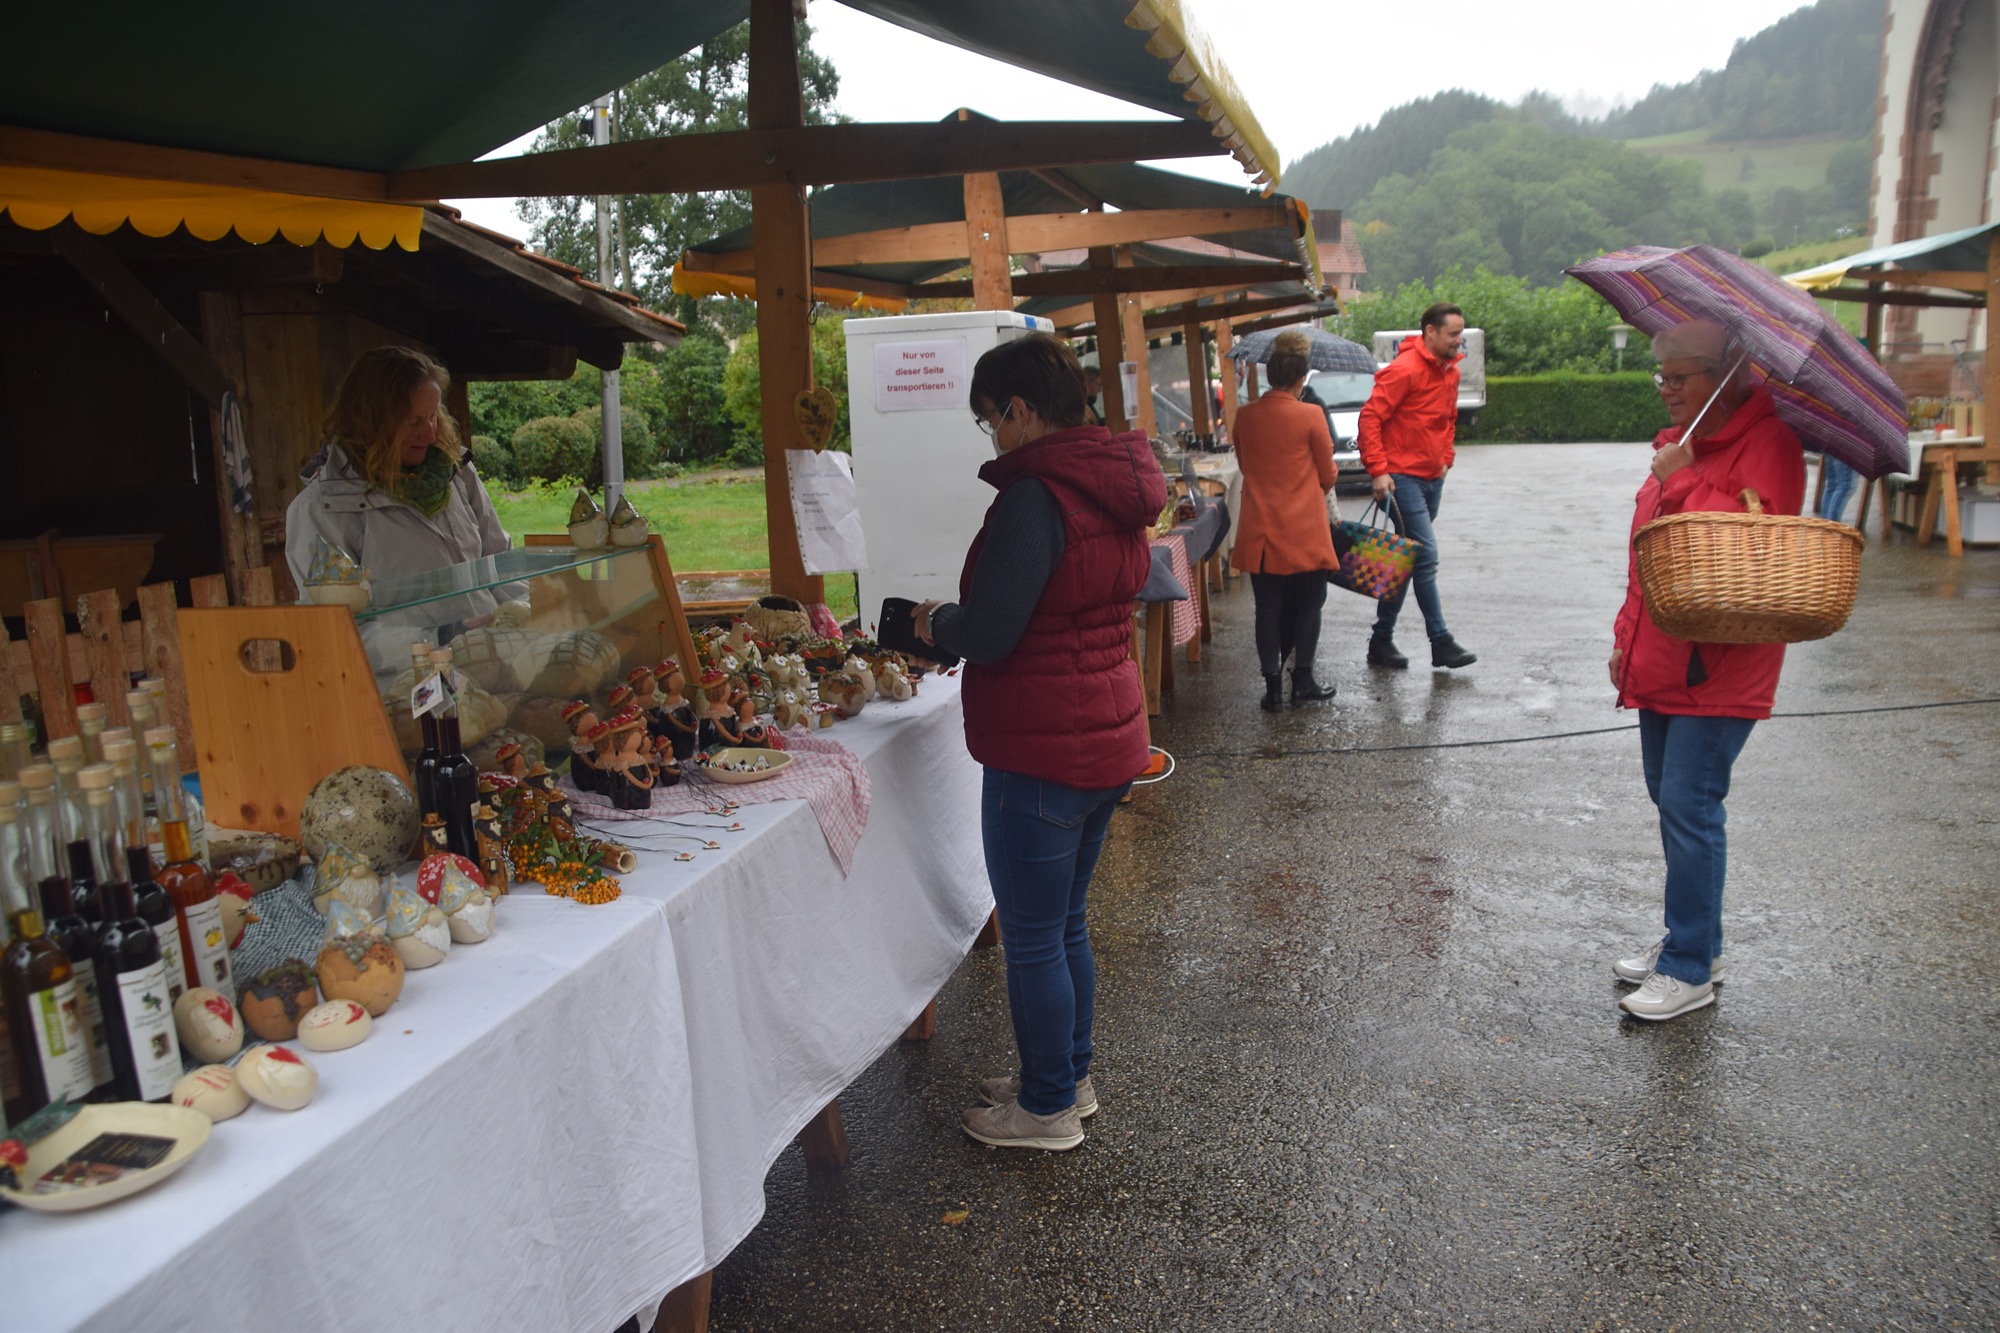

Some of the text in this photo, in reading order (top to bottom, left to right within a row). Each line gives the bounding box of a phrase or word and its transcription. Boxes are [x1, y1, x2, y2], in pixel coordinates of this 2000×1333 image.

[902, 351, 936, 360] Nur von
[895, 366, 945, 376] dieser Seite
[887, 382, 946, 392] transportieren
